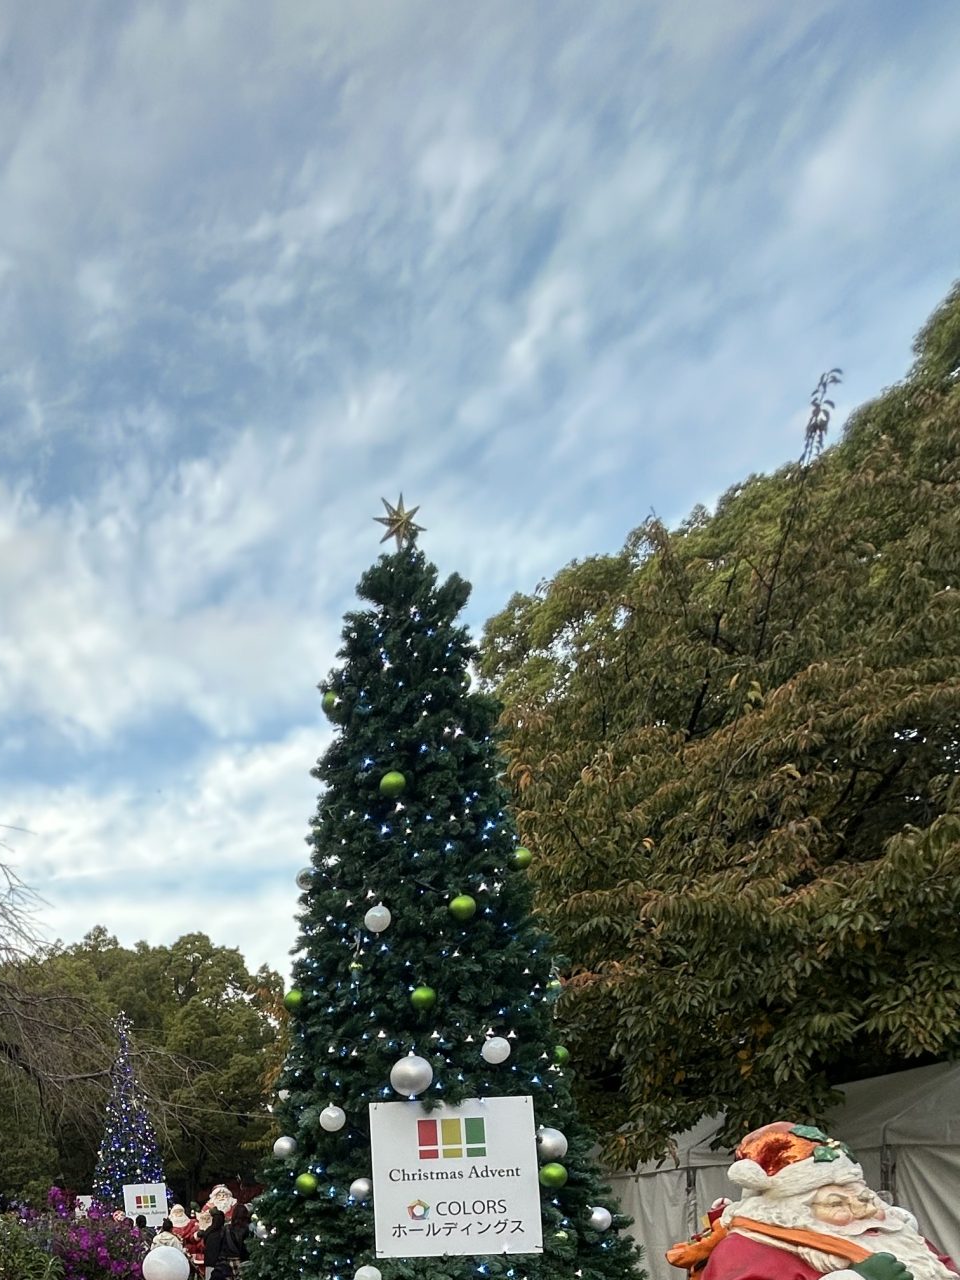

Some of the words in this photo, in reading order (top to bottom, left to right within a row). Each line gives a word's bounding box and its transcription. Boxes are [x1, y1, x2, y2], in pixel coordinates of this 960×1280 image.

[389, 1168, 464, 1182] Christmas
[468, 1165, 521, 1178] Advent
[436, 1199, 507, 1216] COLORS
[392, 1218, 525, 1238] ホールディングス
